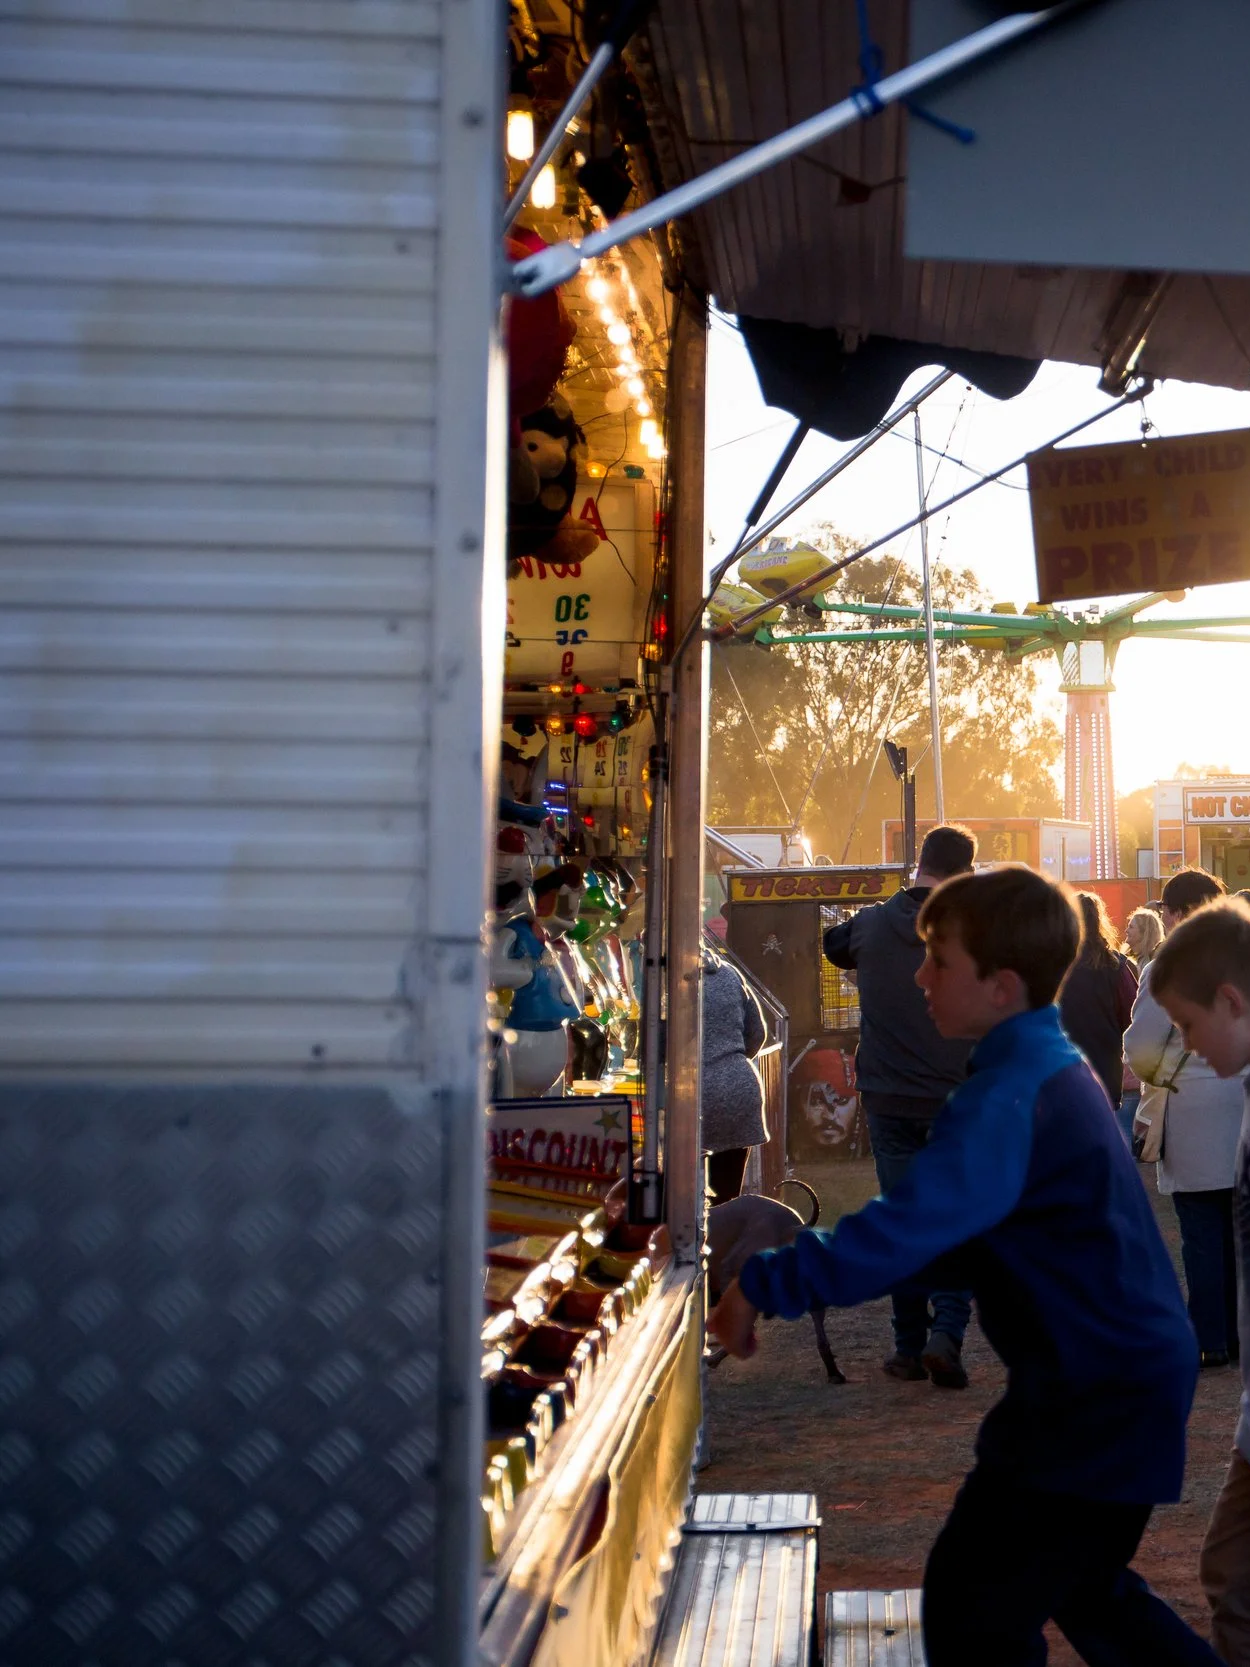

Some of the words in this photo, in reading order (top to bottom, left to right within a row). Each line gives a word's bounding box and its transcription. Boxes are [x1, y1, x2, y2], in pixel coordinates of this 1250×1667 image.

[1153, 443, 1246, 478] CHILD
[1061, 497, 1148, 532] WINS
[1189, 490, 1211, 518] A
[1043, 530, 1241, 596] PRIZE
[1191, 796, 1227, 818] HOT
[739, 875, 886, 898] TICKETS
